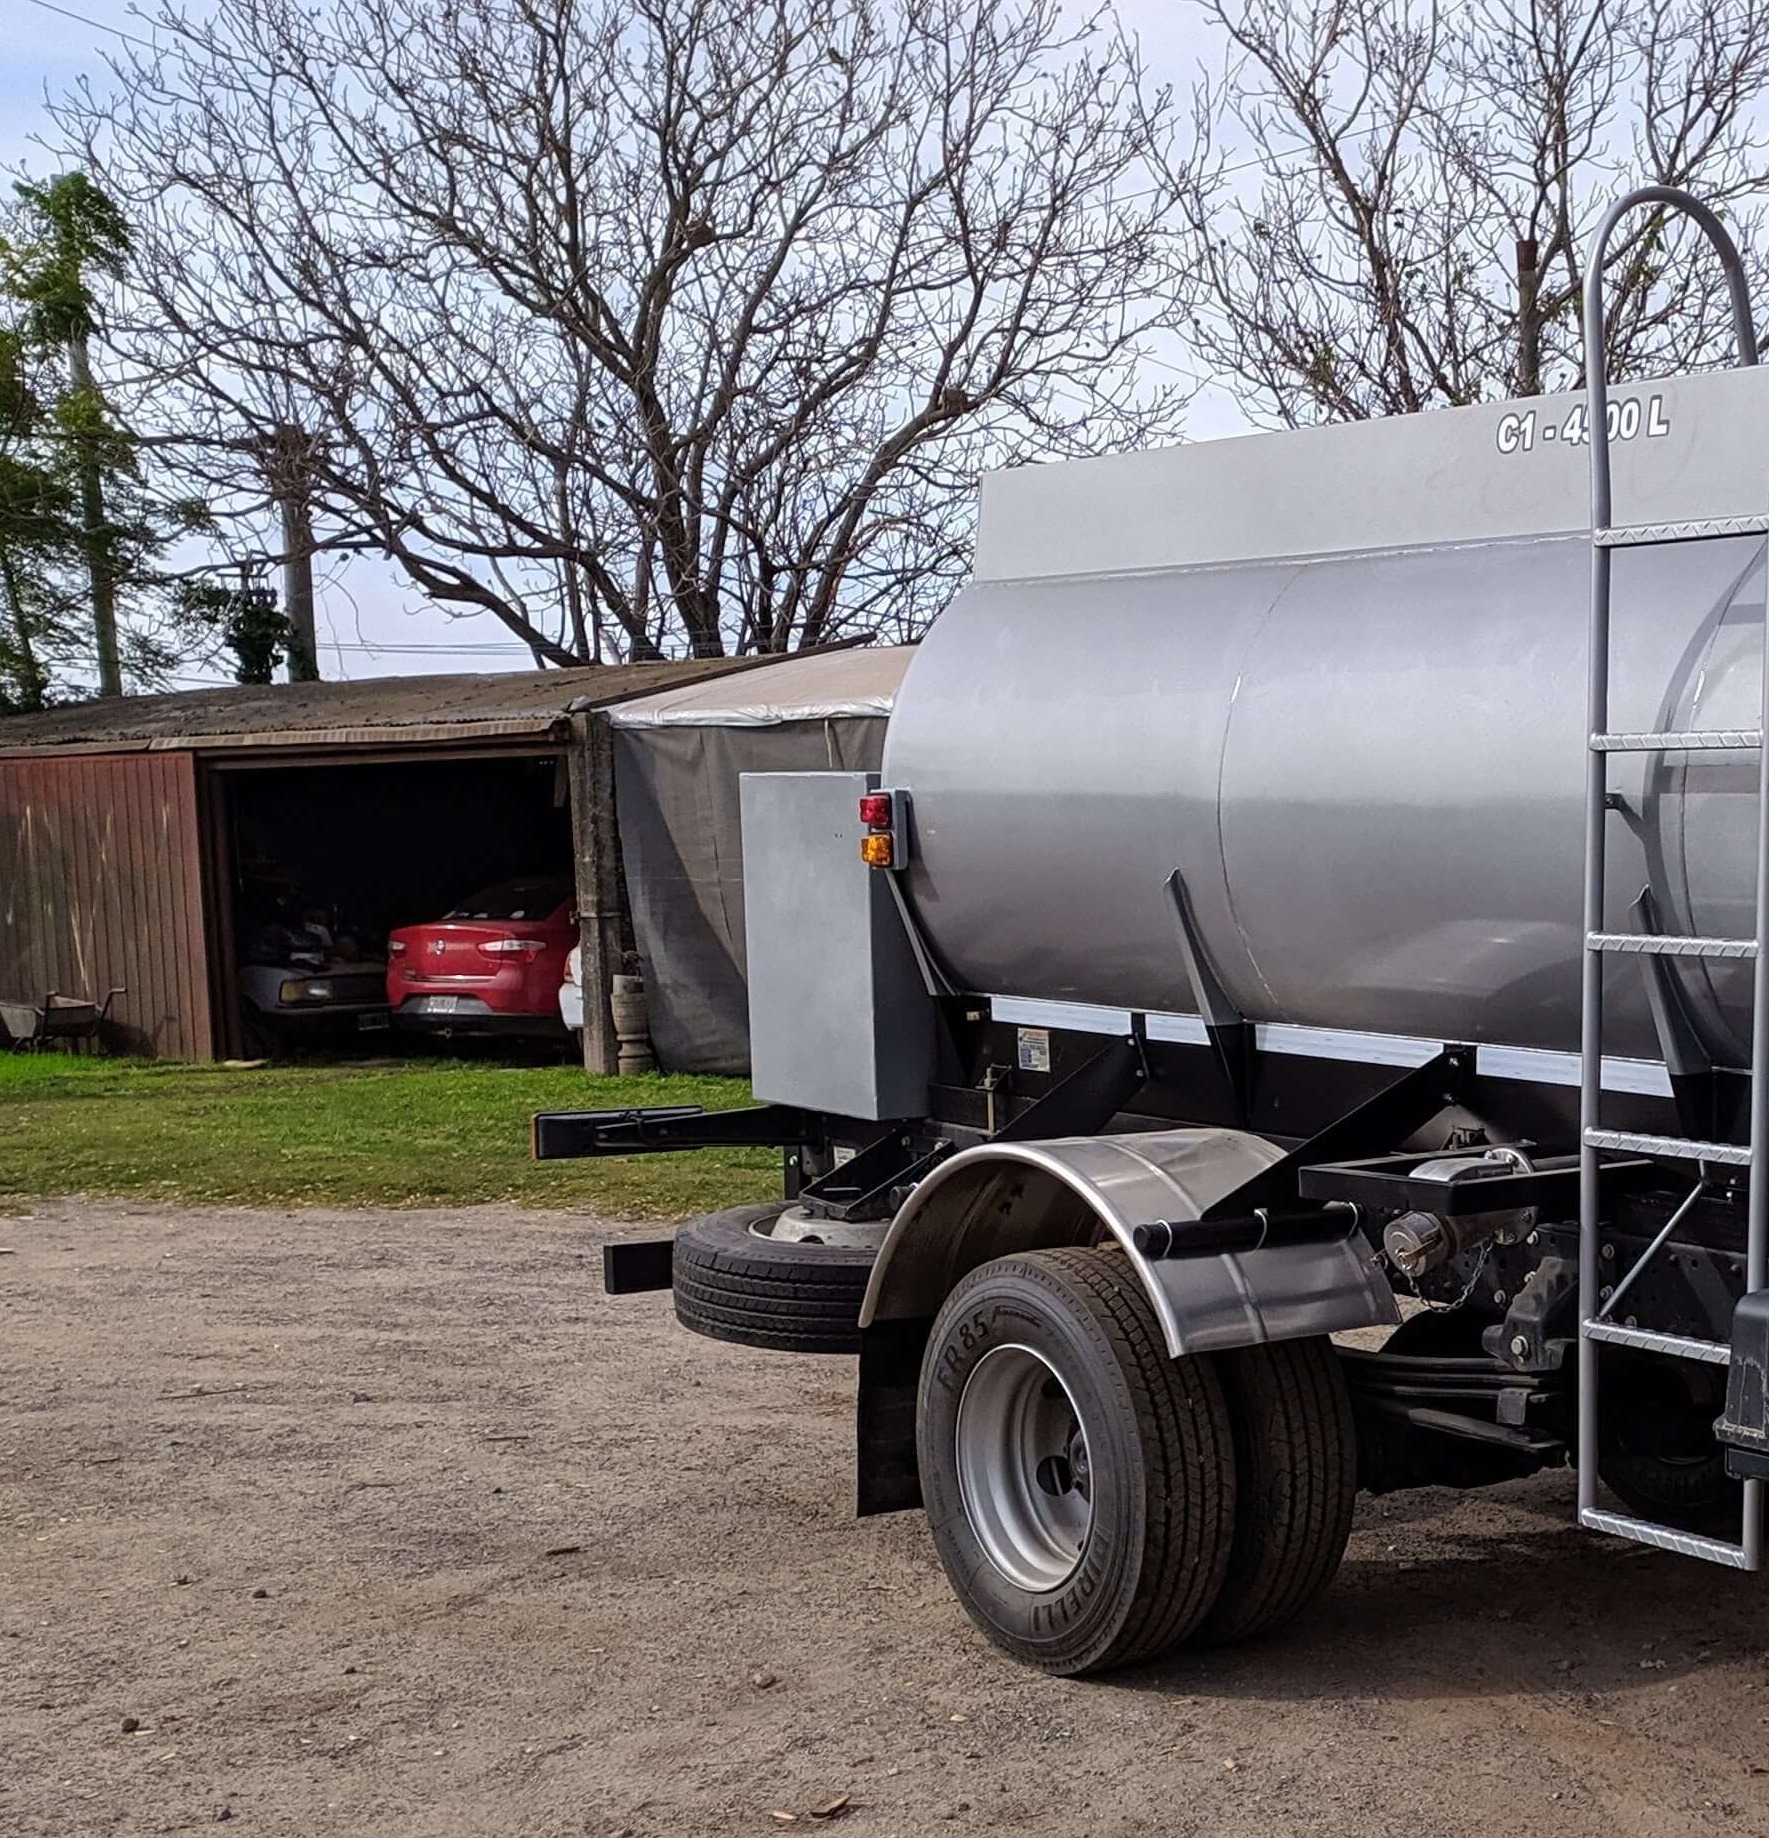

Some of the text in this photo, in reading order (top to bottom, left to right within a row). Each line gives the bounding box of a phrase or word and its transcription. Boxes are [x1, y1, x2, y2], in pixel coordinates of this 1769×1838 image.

[1497, 410, 1536, 454] C1
[1561, 397, 1640, 446] 400
[1647, 395, 1669, 437] L
